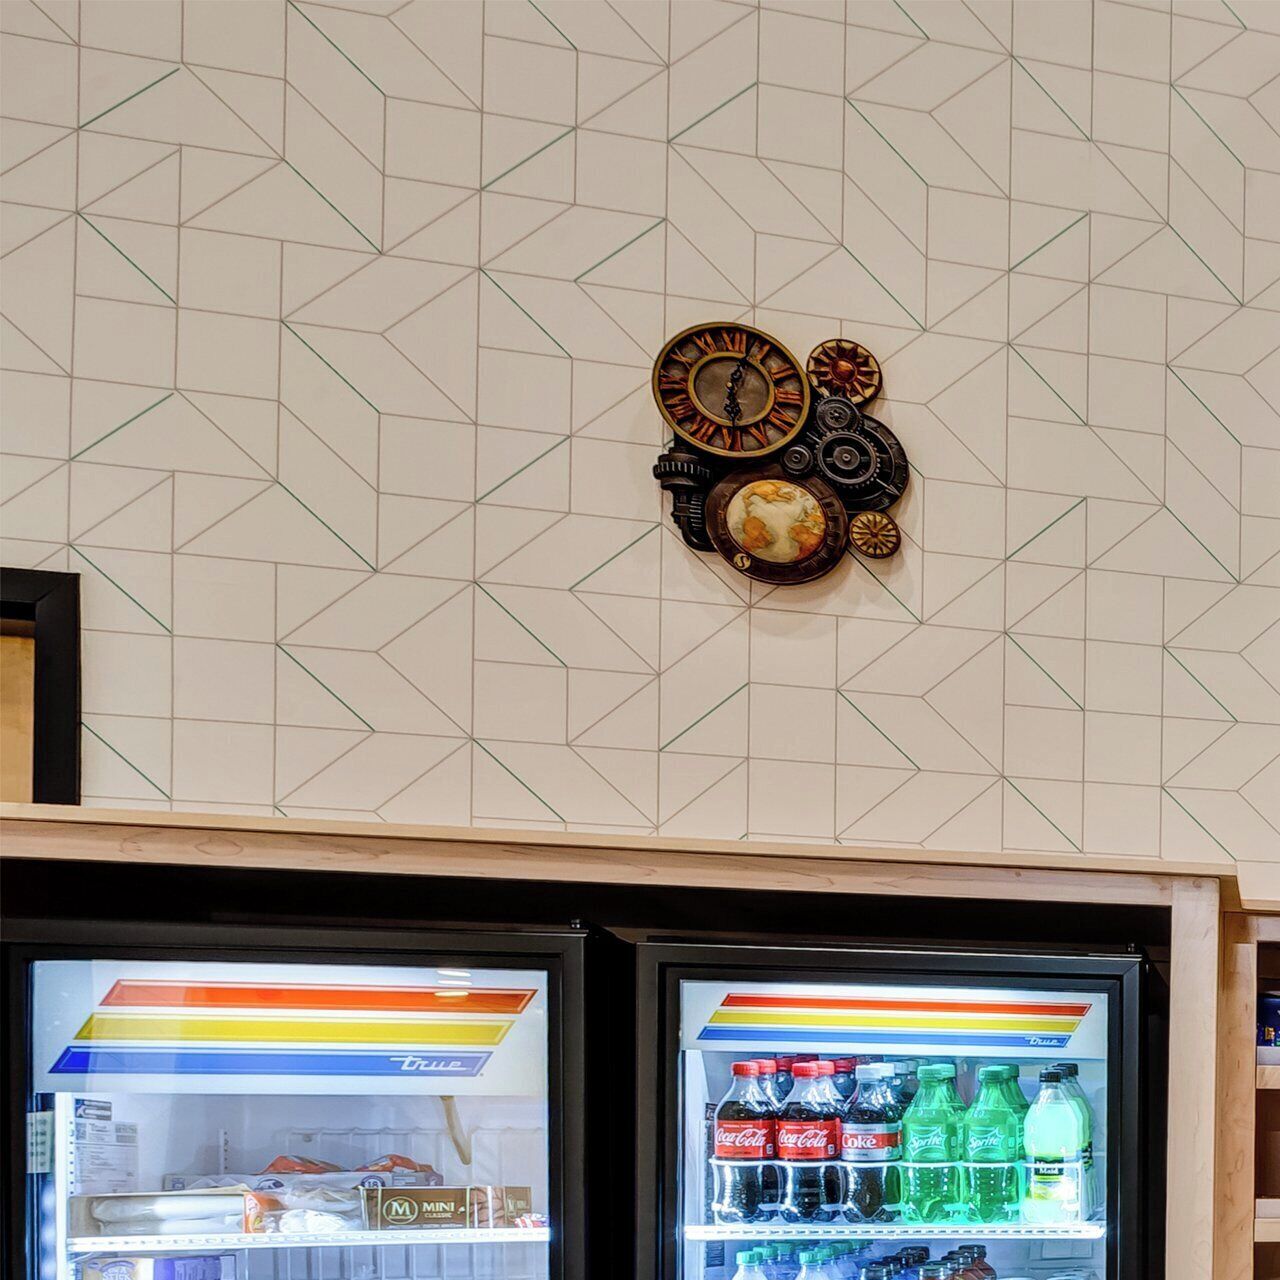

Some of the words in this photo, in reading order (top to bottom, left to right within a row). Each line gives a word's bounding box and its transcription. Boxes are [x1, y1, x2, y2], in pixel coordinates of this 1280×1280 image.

[716, 1127, 769, 1148] Coca-Cola
[778, 1128, 832, 1148] Coca-Cola
[842, 1134, 878, 1149] Coke
[911, 1132, 943, 1148] Sprite
[968, 1132, 1001, 1148] Sprite
[422, 1202, 455, 1213] MINI
